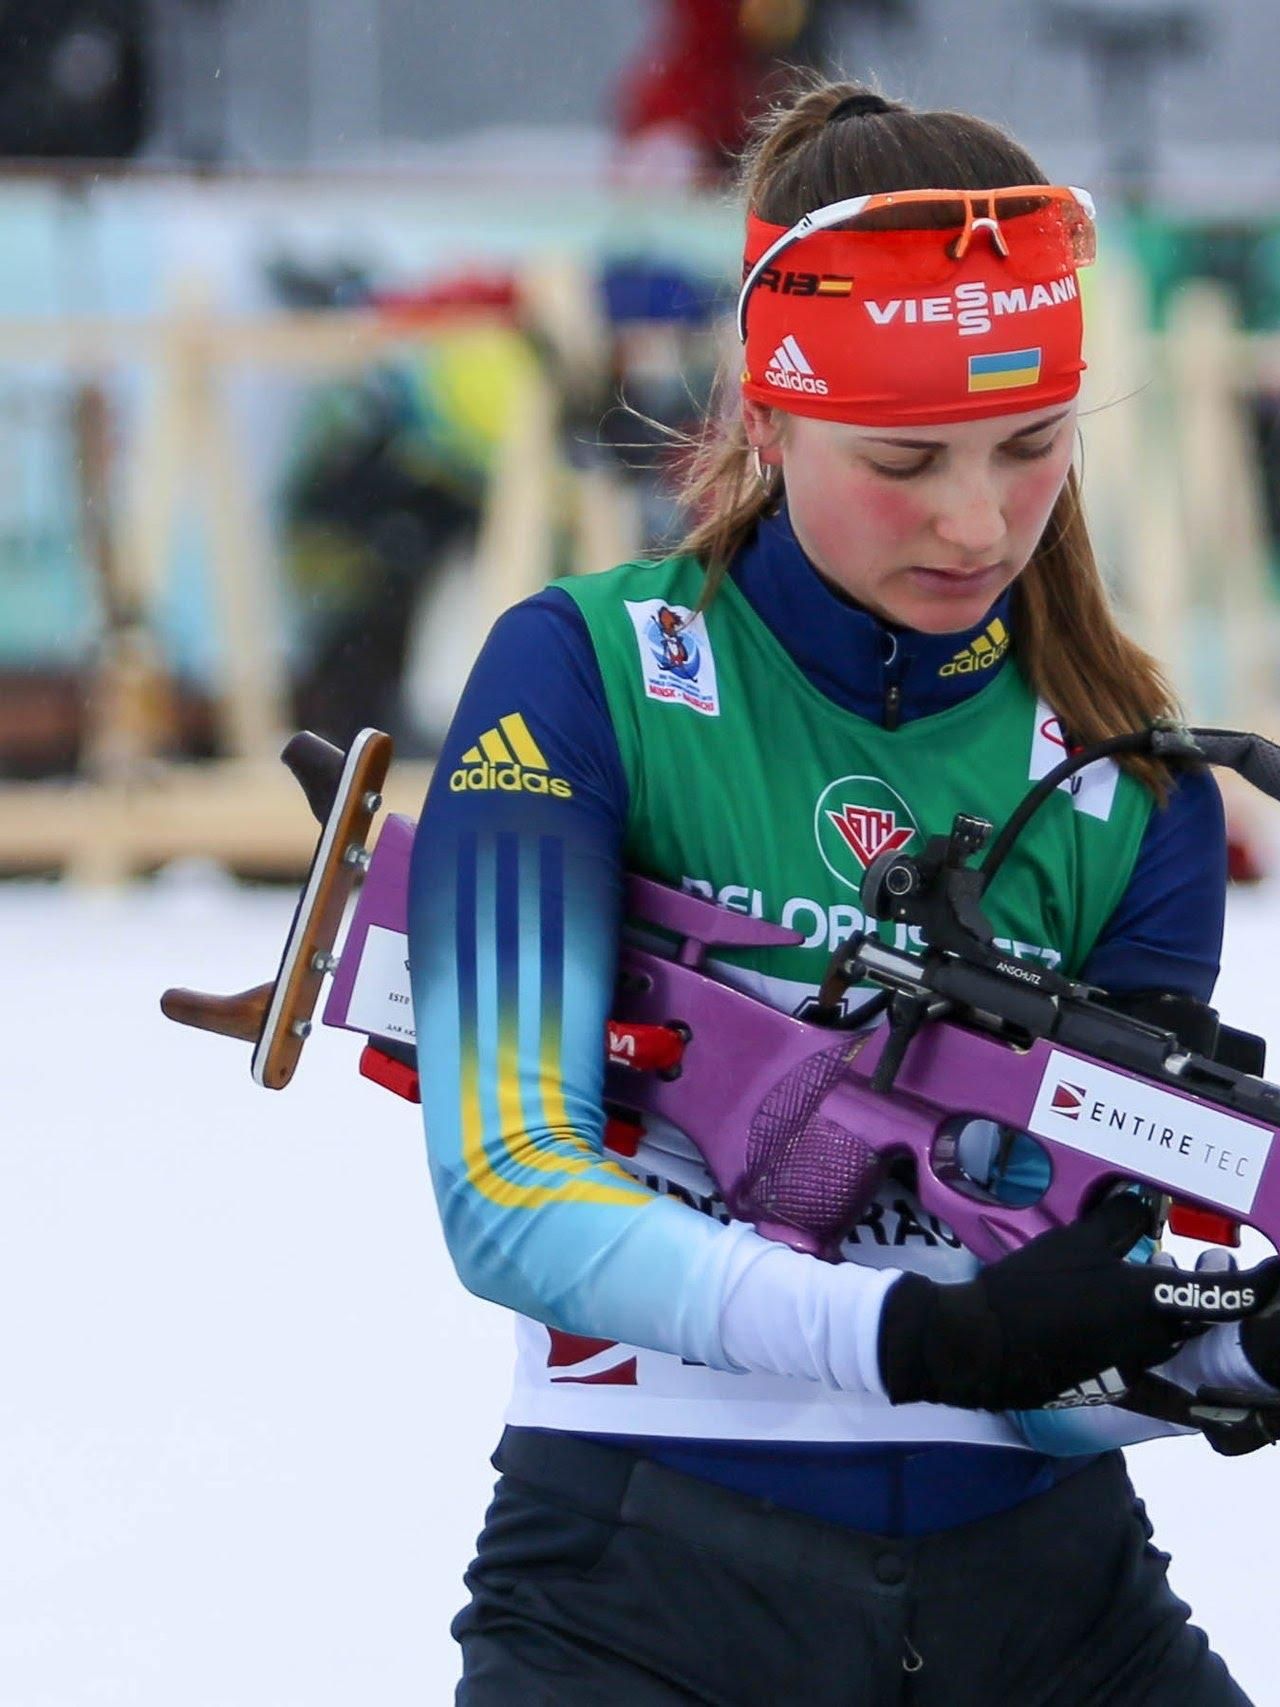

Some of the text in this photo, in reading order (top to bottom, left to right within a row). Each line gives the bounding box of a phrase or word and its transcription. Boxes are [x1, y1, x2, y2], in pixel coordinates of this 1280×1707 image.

[864, 275, 1078, 336] VIESSMANN
[765, 368, 829, 395] adidas
[450, 761, 573, 798] adidas
[1090, 1102, 1251, 1178] ENTIRE TEC
[1154, 1282, 1255, 1310] adidas
